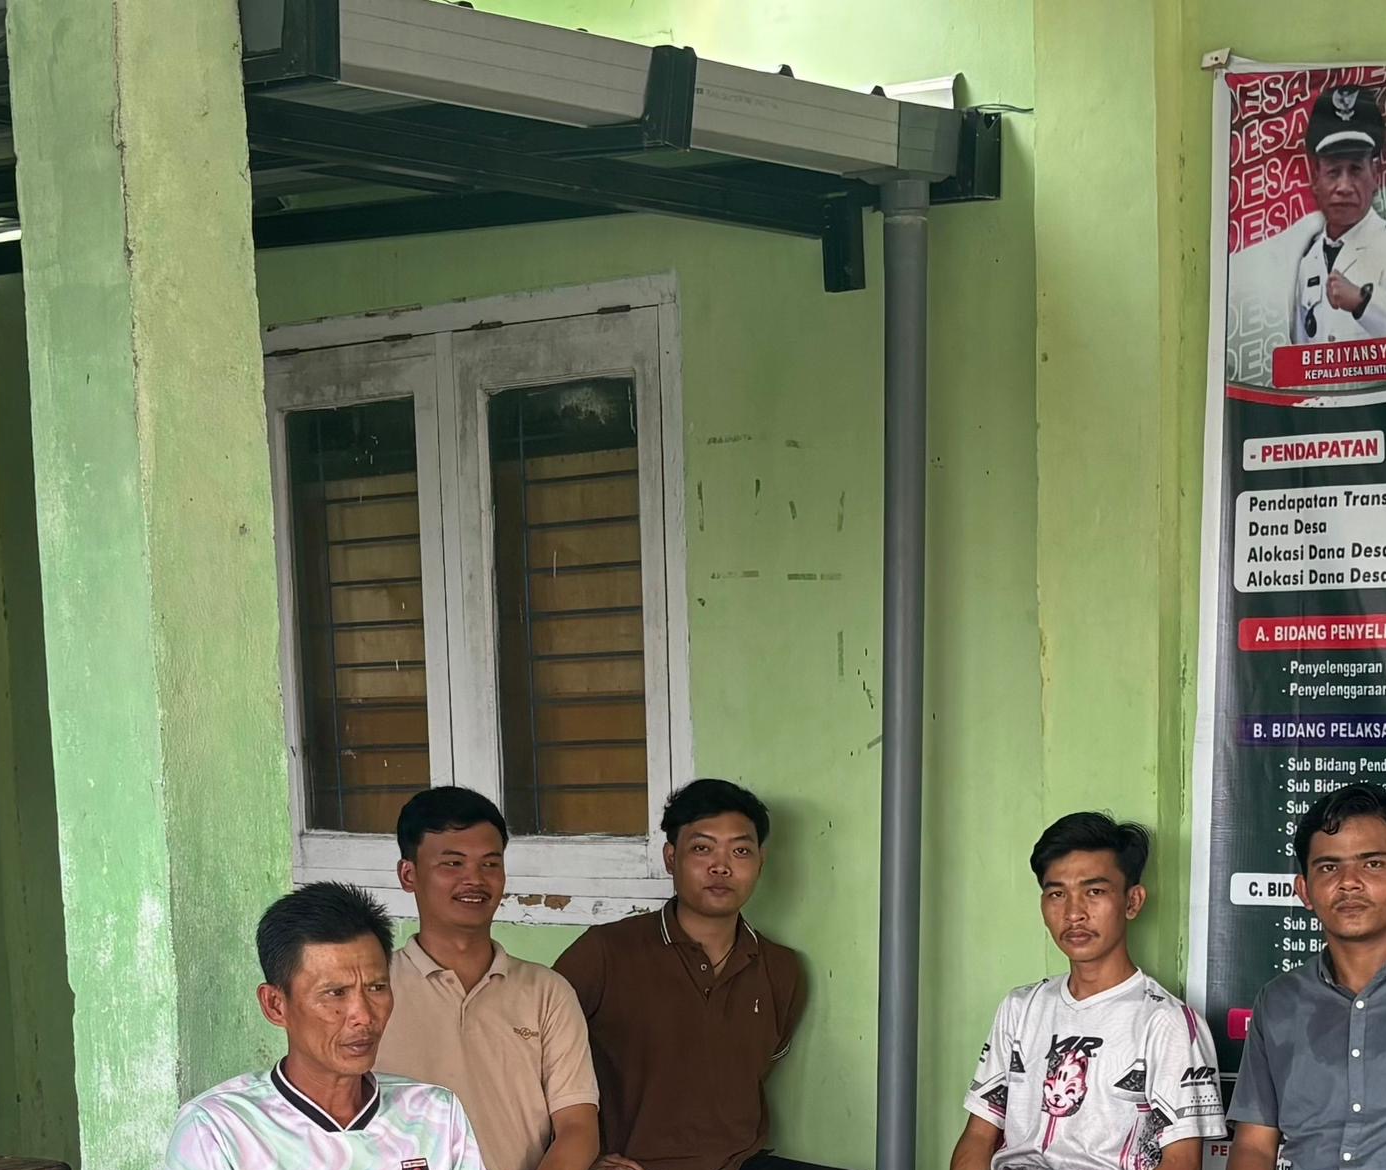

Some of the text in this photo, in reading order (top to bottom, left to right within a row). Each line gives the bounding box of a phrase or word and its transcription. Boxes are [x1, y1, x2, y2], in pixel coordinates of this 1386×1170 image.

[1304, 365, 1341, 380] KEPALA
[1342, 364, 1363, 378] DESA
[1261, 437, 1379, 463] PENDAPATAN
[1249, 493, 1338, 514] Pendapatan
[1248, 519, 1327, 537] Dana Desa
[1247, 544, 1304, 563] Alokasi
[1308, 543, 1345, 561] Dana
[1246, 569, 1304, 588] Alokasi
[1308, 568, 1344, 585] Dana
[1255, 626, 1269, 642] A.
[1274, 625, 1327, 641] BIDANG
[1290, 659, 1383, 677] Penyelenggaran
[1253, 723, 1266, 738] B.
[1272, 723, 1326, 738] BIDANG
[1287, 758, 1311, 772] Sub
[1315, 758, 1356, 775] Bidang
[1287, 779, 1355, 793] Sub Bida
[1286, 801, 1310, 814] Sub
[1248, 882, 1263, 897] C.
[1283, 917, 1307, 931] Sub
[1282, 938, 1306, 951] Sub
